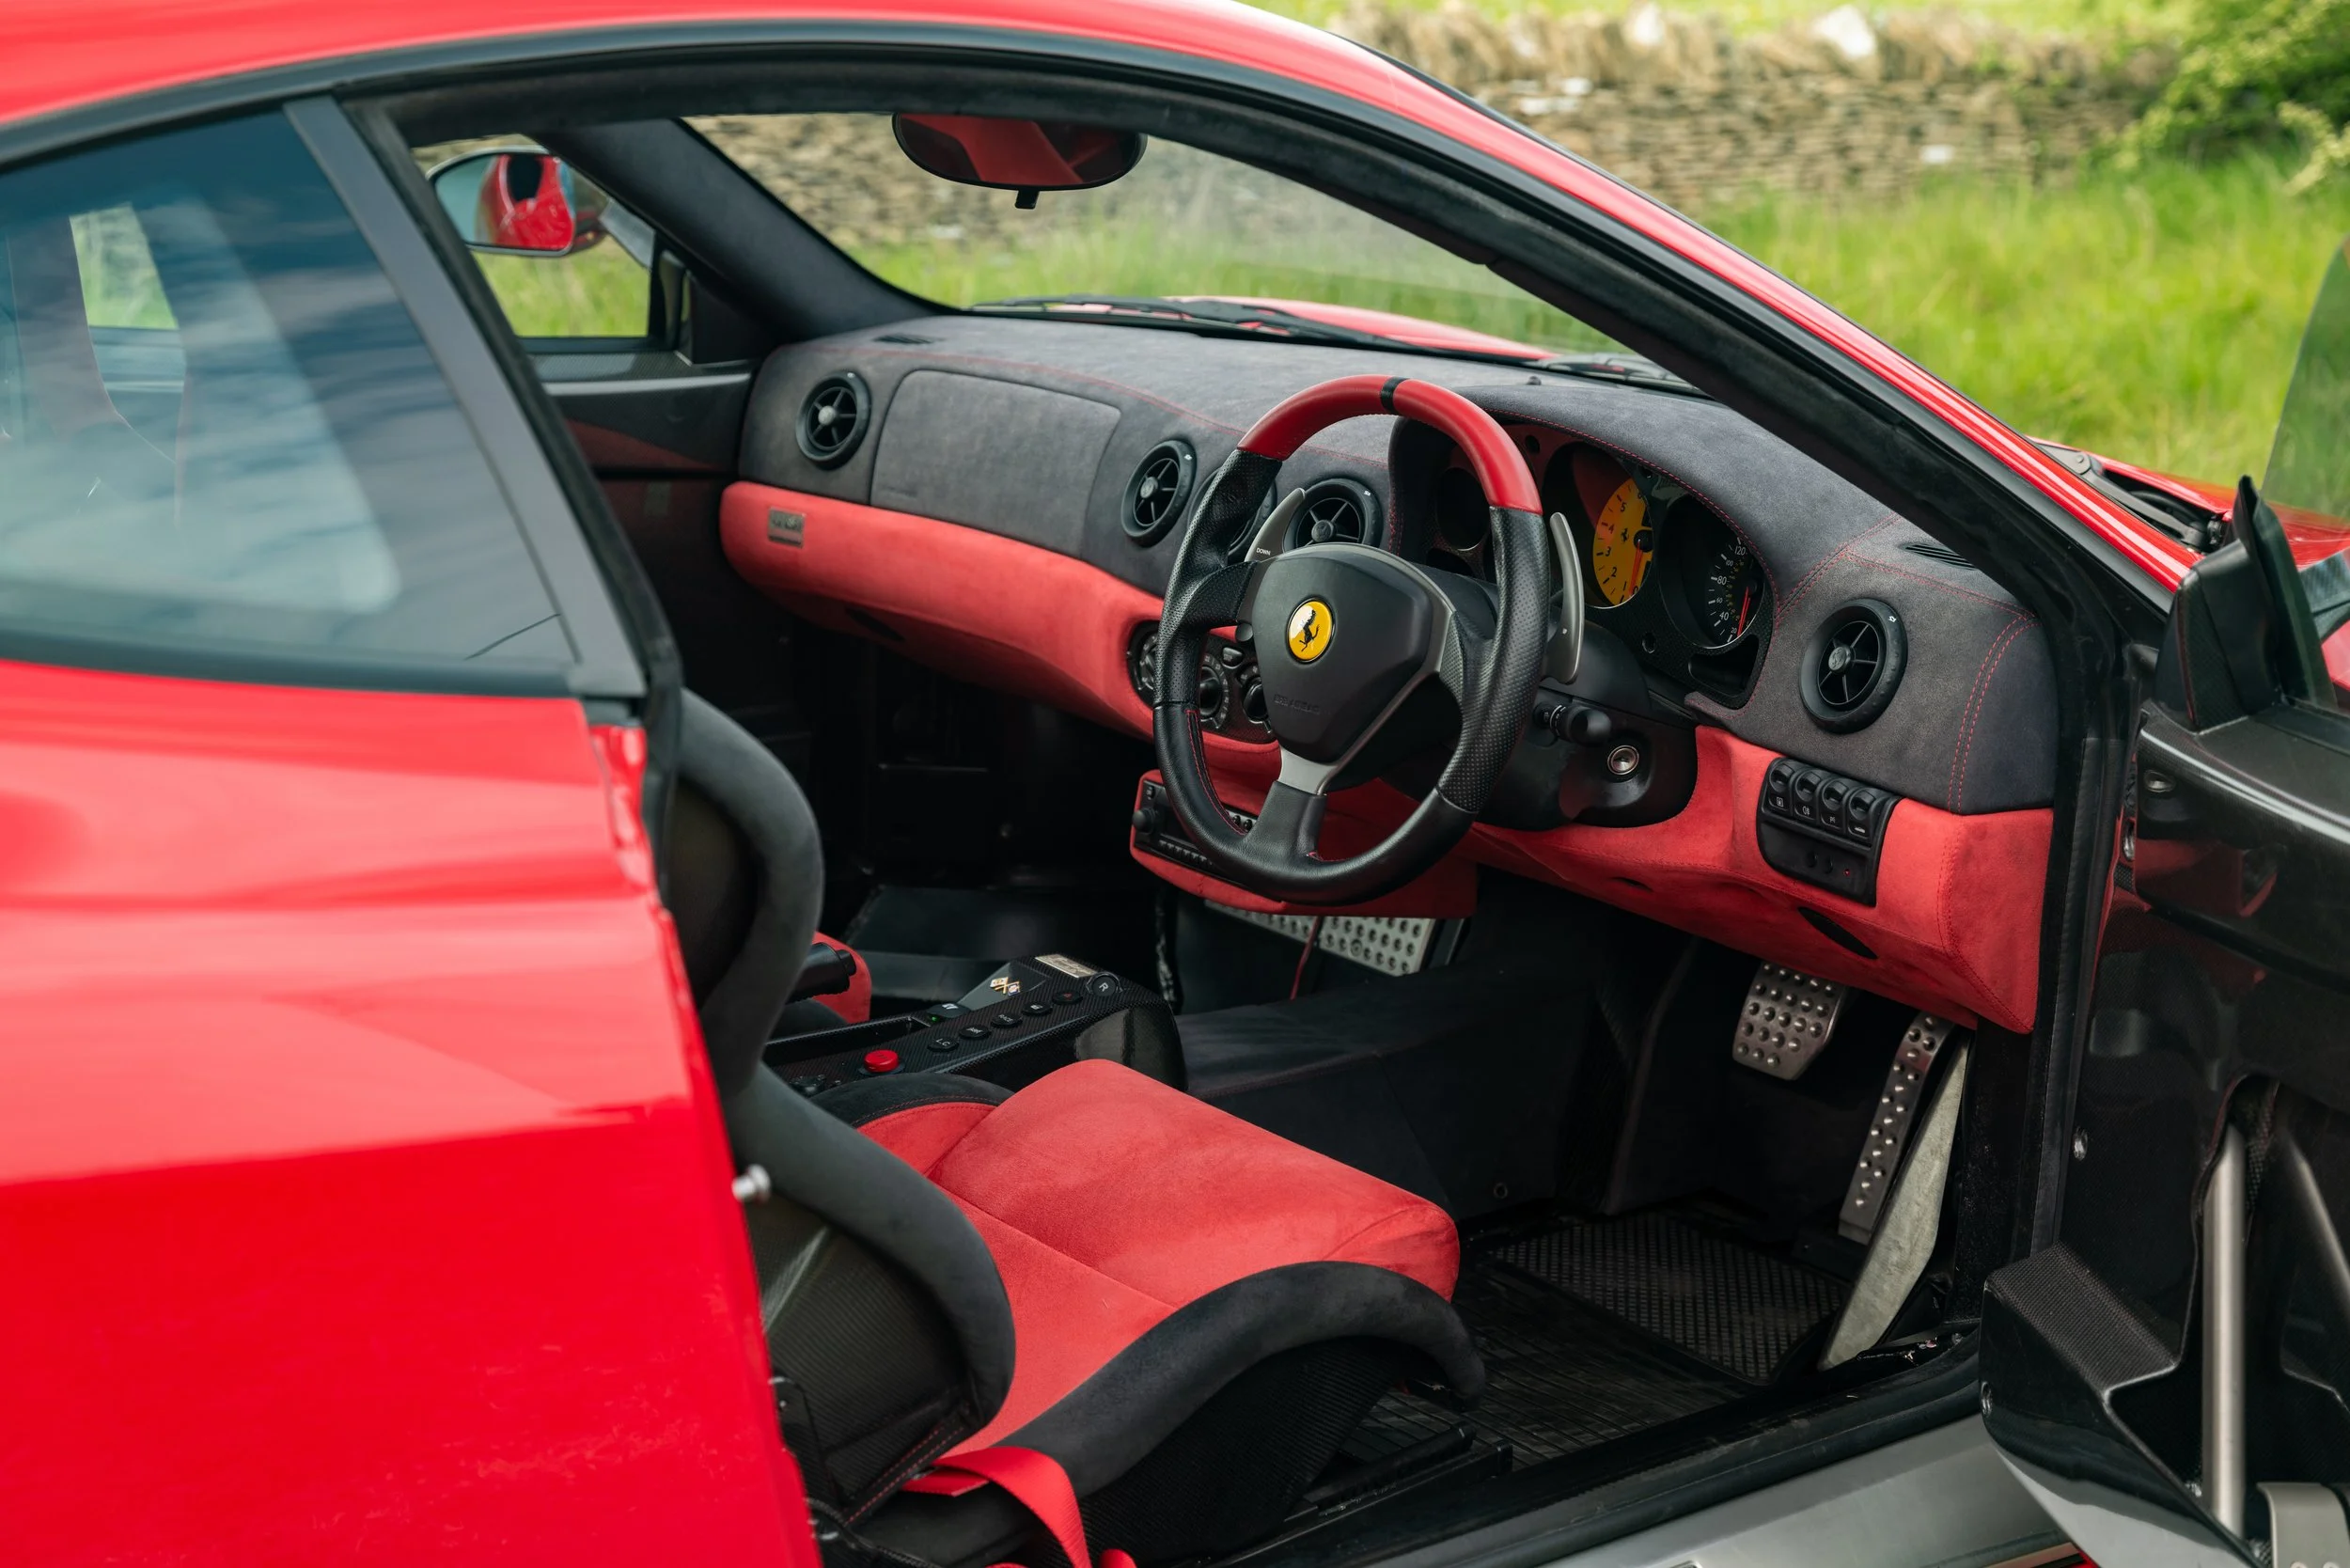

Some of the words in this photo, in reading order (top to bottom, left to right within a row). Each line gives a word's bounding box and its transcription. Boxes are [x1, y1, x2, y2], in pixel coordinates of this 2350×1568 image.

[1621, 502, 1627, 512] 5
[1608, 523, 1614, 534] 4
[1256, 547, 1271, 556] DOWN
[1605, 546, 1611, 557] 3
[1734, 545, 1747, 556] 120
[1725, 558, 1734, 567] 100
[1611, 566, 1617, 577] 2
[1716, 575, 1727, 586] 80
[1719, 611, 1730, 621] 40
[1098, 981, 1109, 993] R
